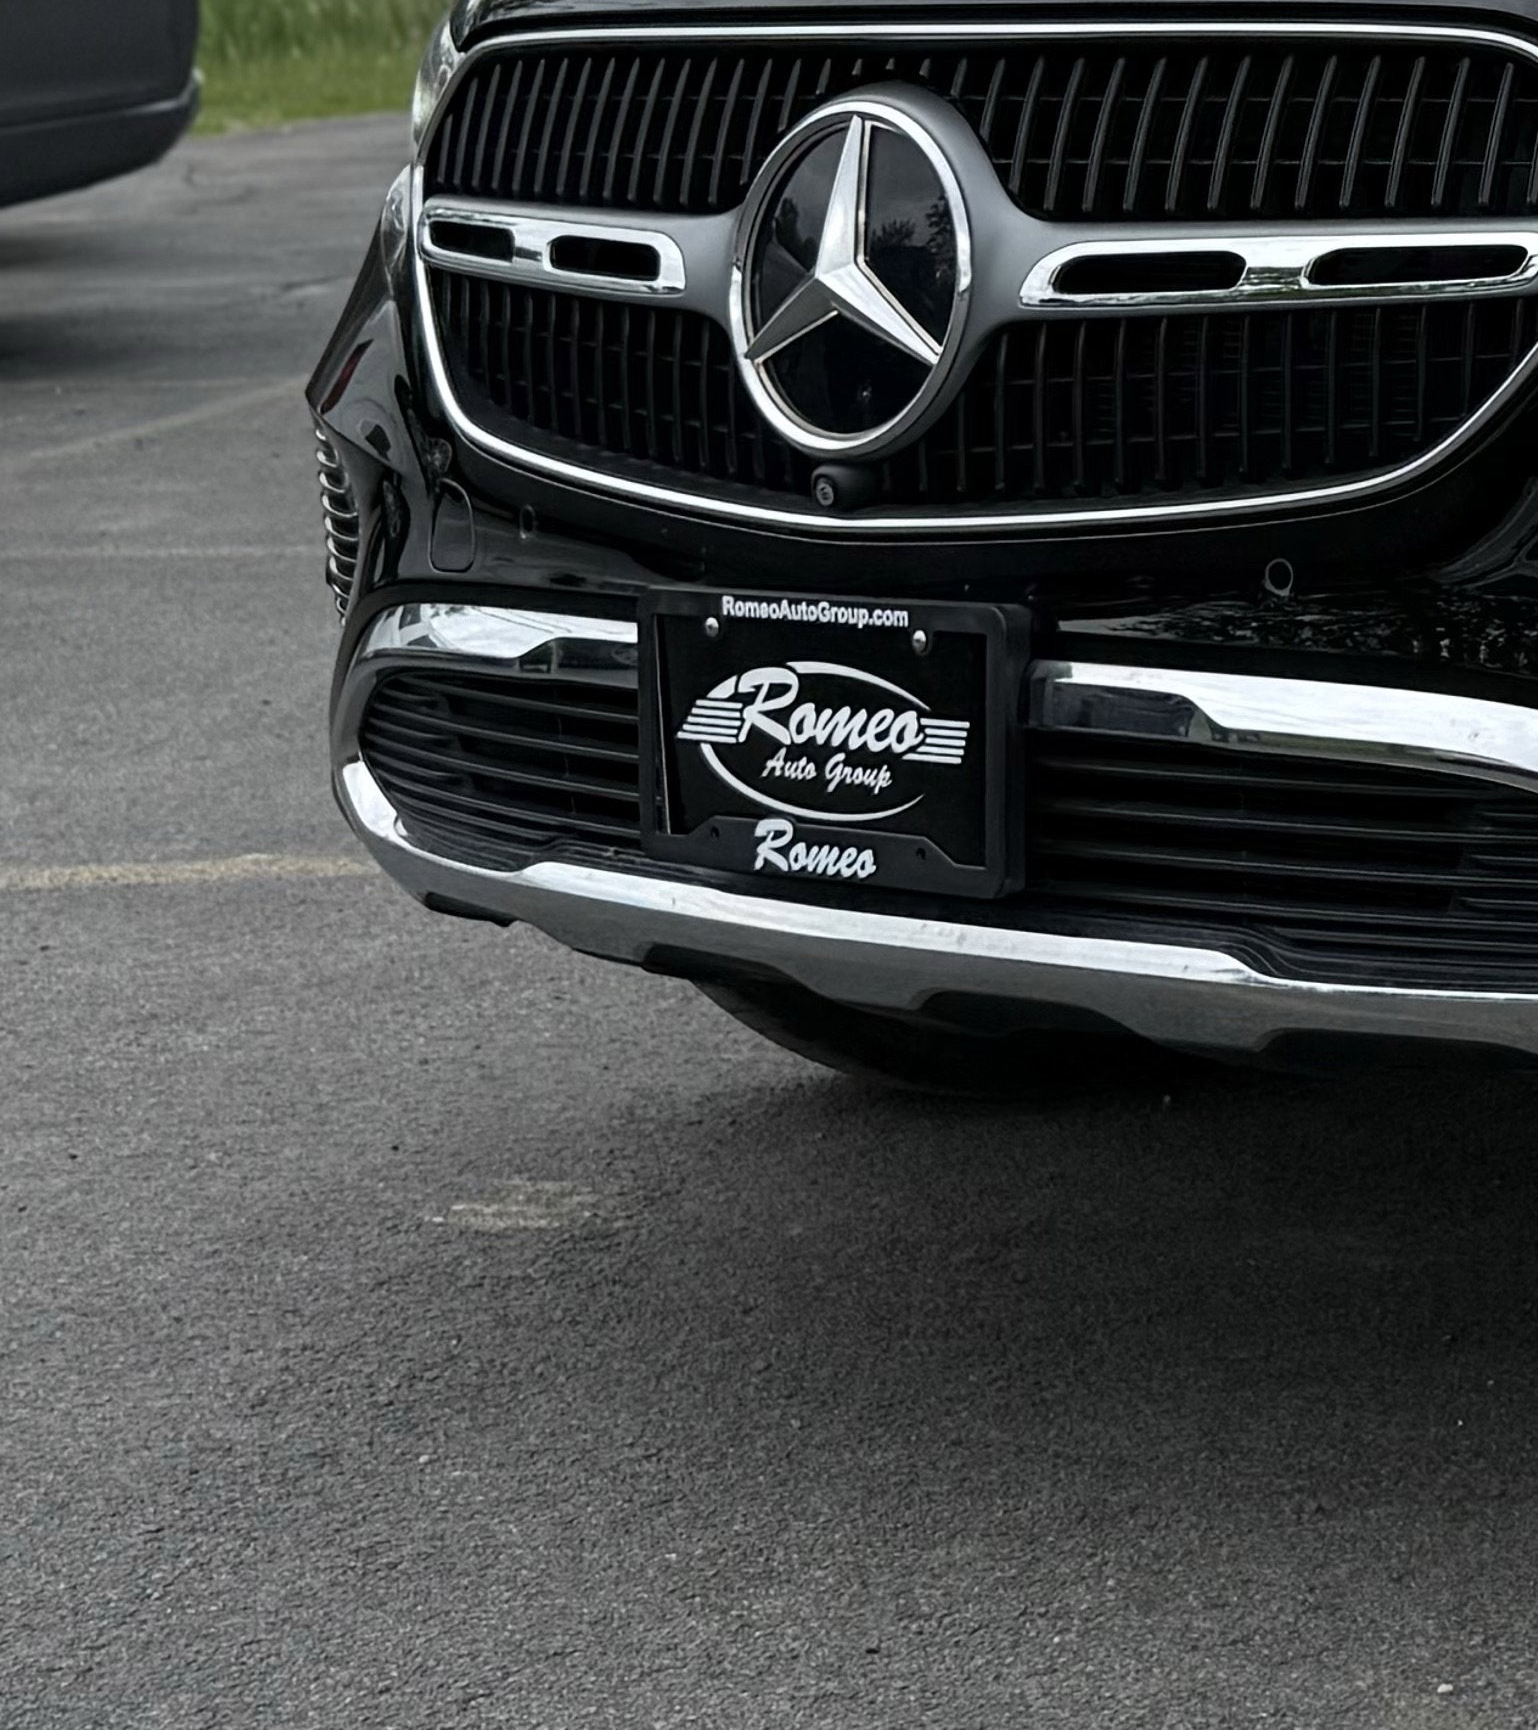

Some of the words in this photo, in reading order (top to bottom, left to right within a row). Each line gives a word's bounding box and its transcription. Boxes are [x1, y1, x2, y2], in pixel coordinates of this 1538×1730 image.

[721, 595, 910, 629] RomeoAutoGroup.com
[737, 666, 924, 754] Romeo
[761, 746, 818, 781] Auto
[824, 753, 893, 796] Group
[753, 817, 877, 879] Romeo
